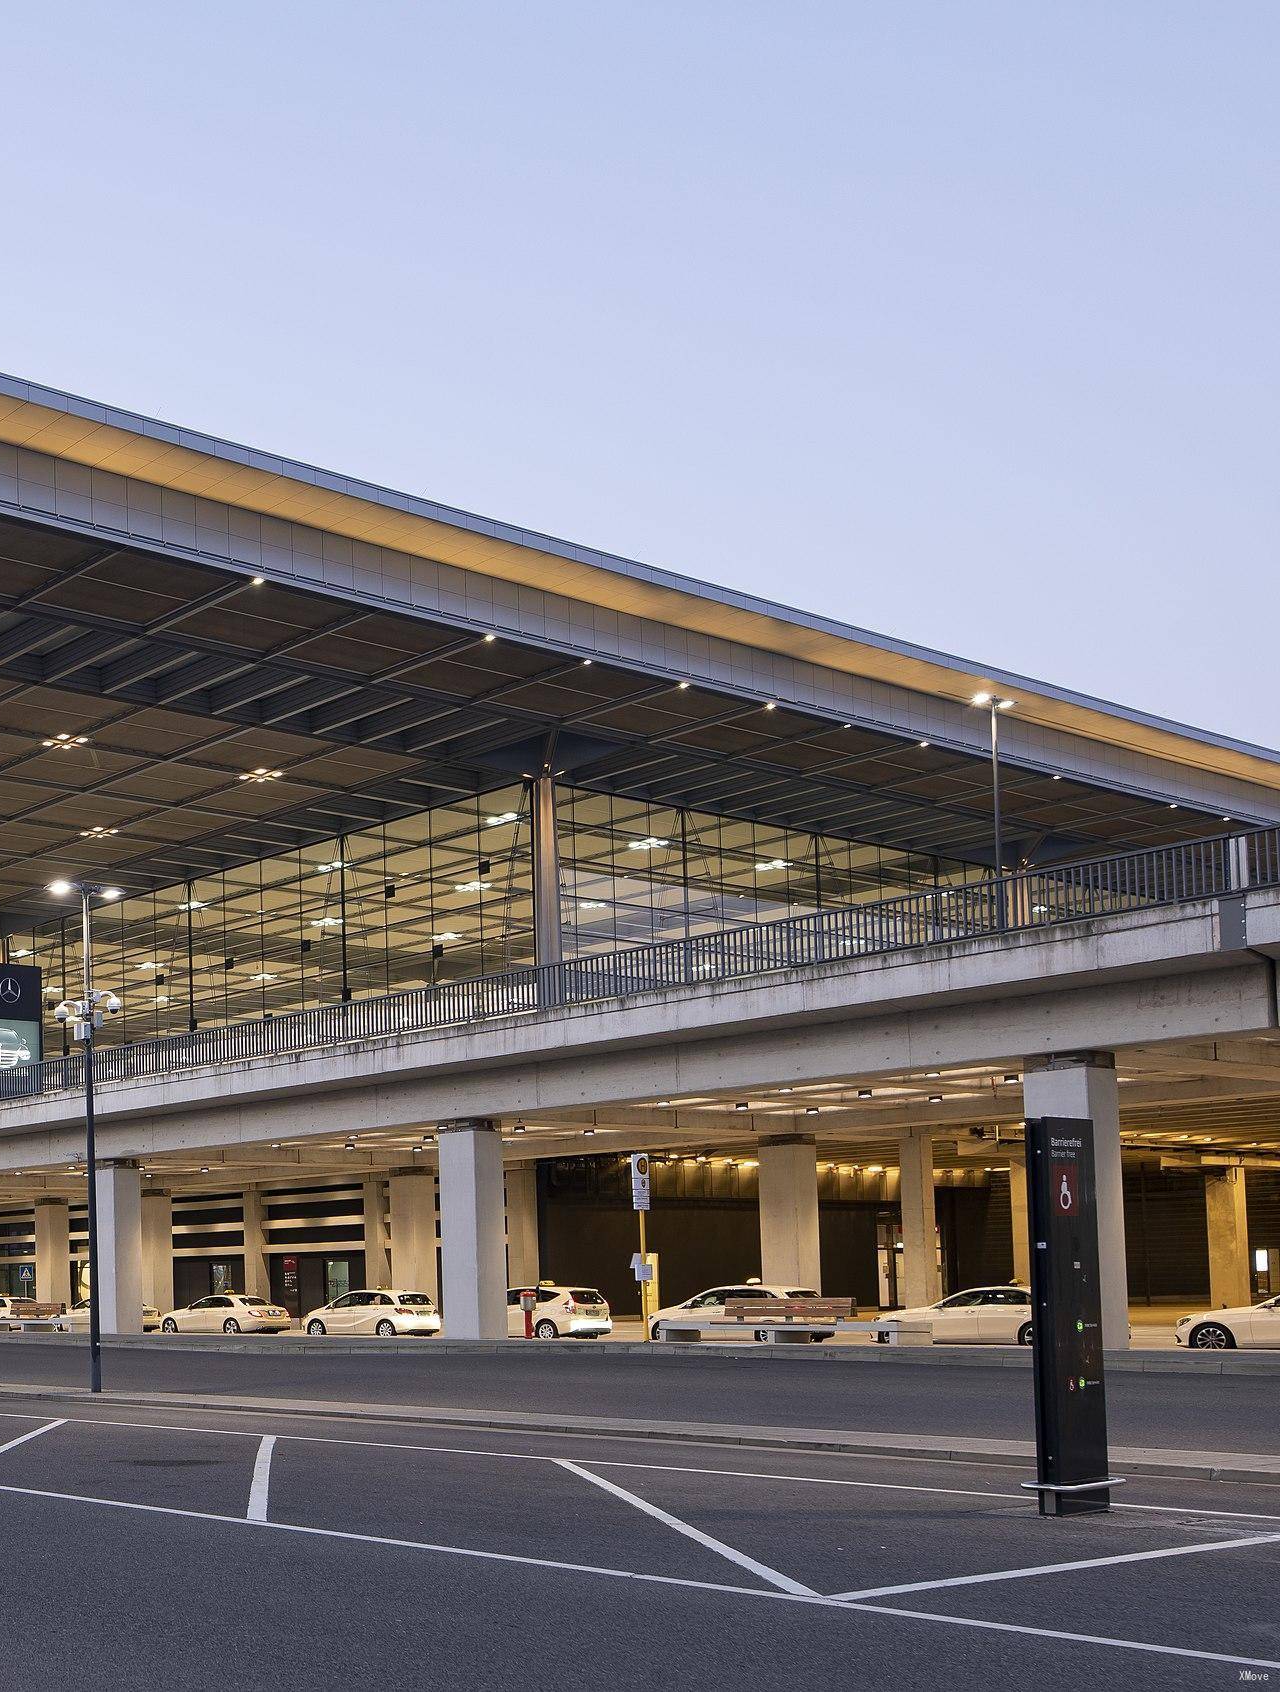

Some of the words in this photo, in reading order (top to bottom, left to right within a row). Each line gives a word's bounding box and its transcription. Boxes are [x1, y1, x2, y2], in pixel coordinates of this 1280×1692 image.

[1050, 1137, 1082, 1148] Barrierefrei
[1051, 1149, 1066, 1158] Barrier
[1067, 1150, 1076, 1158] free
